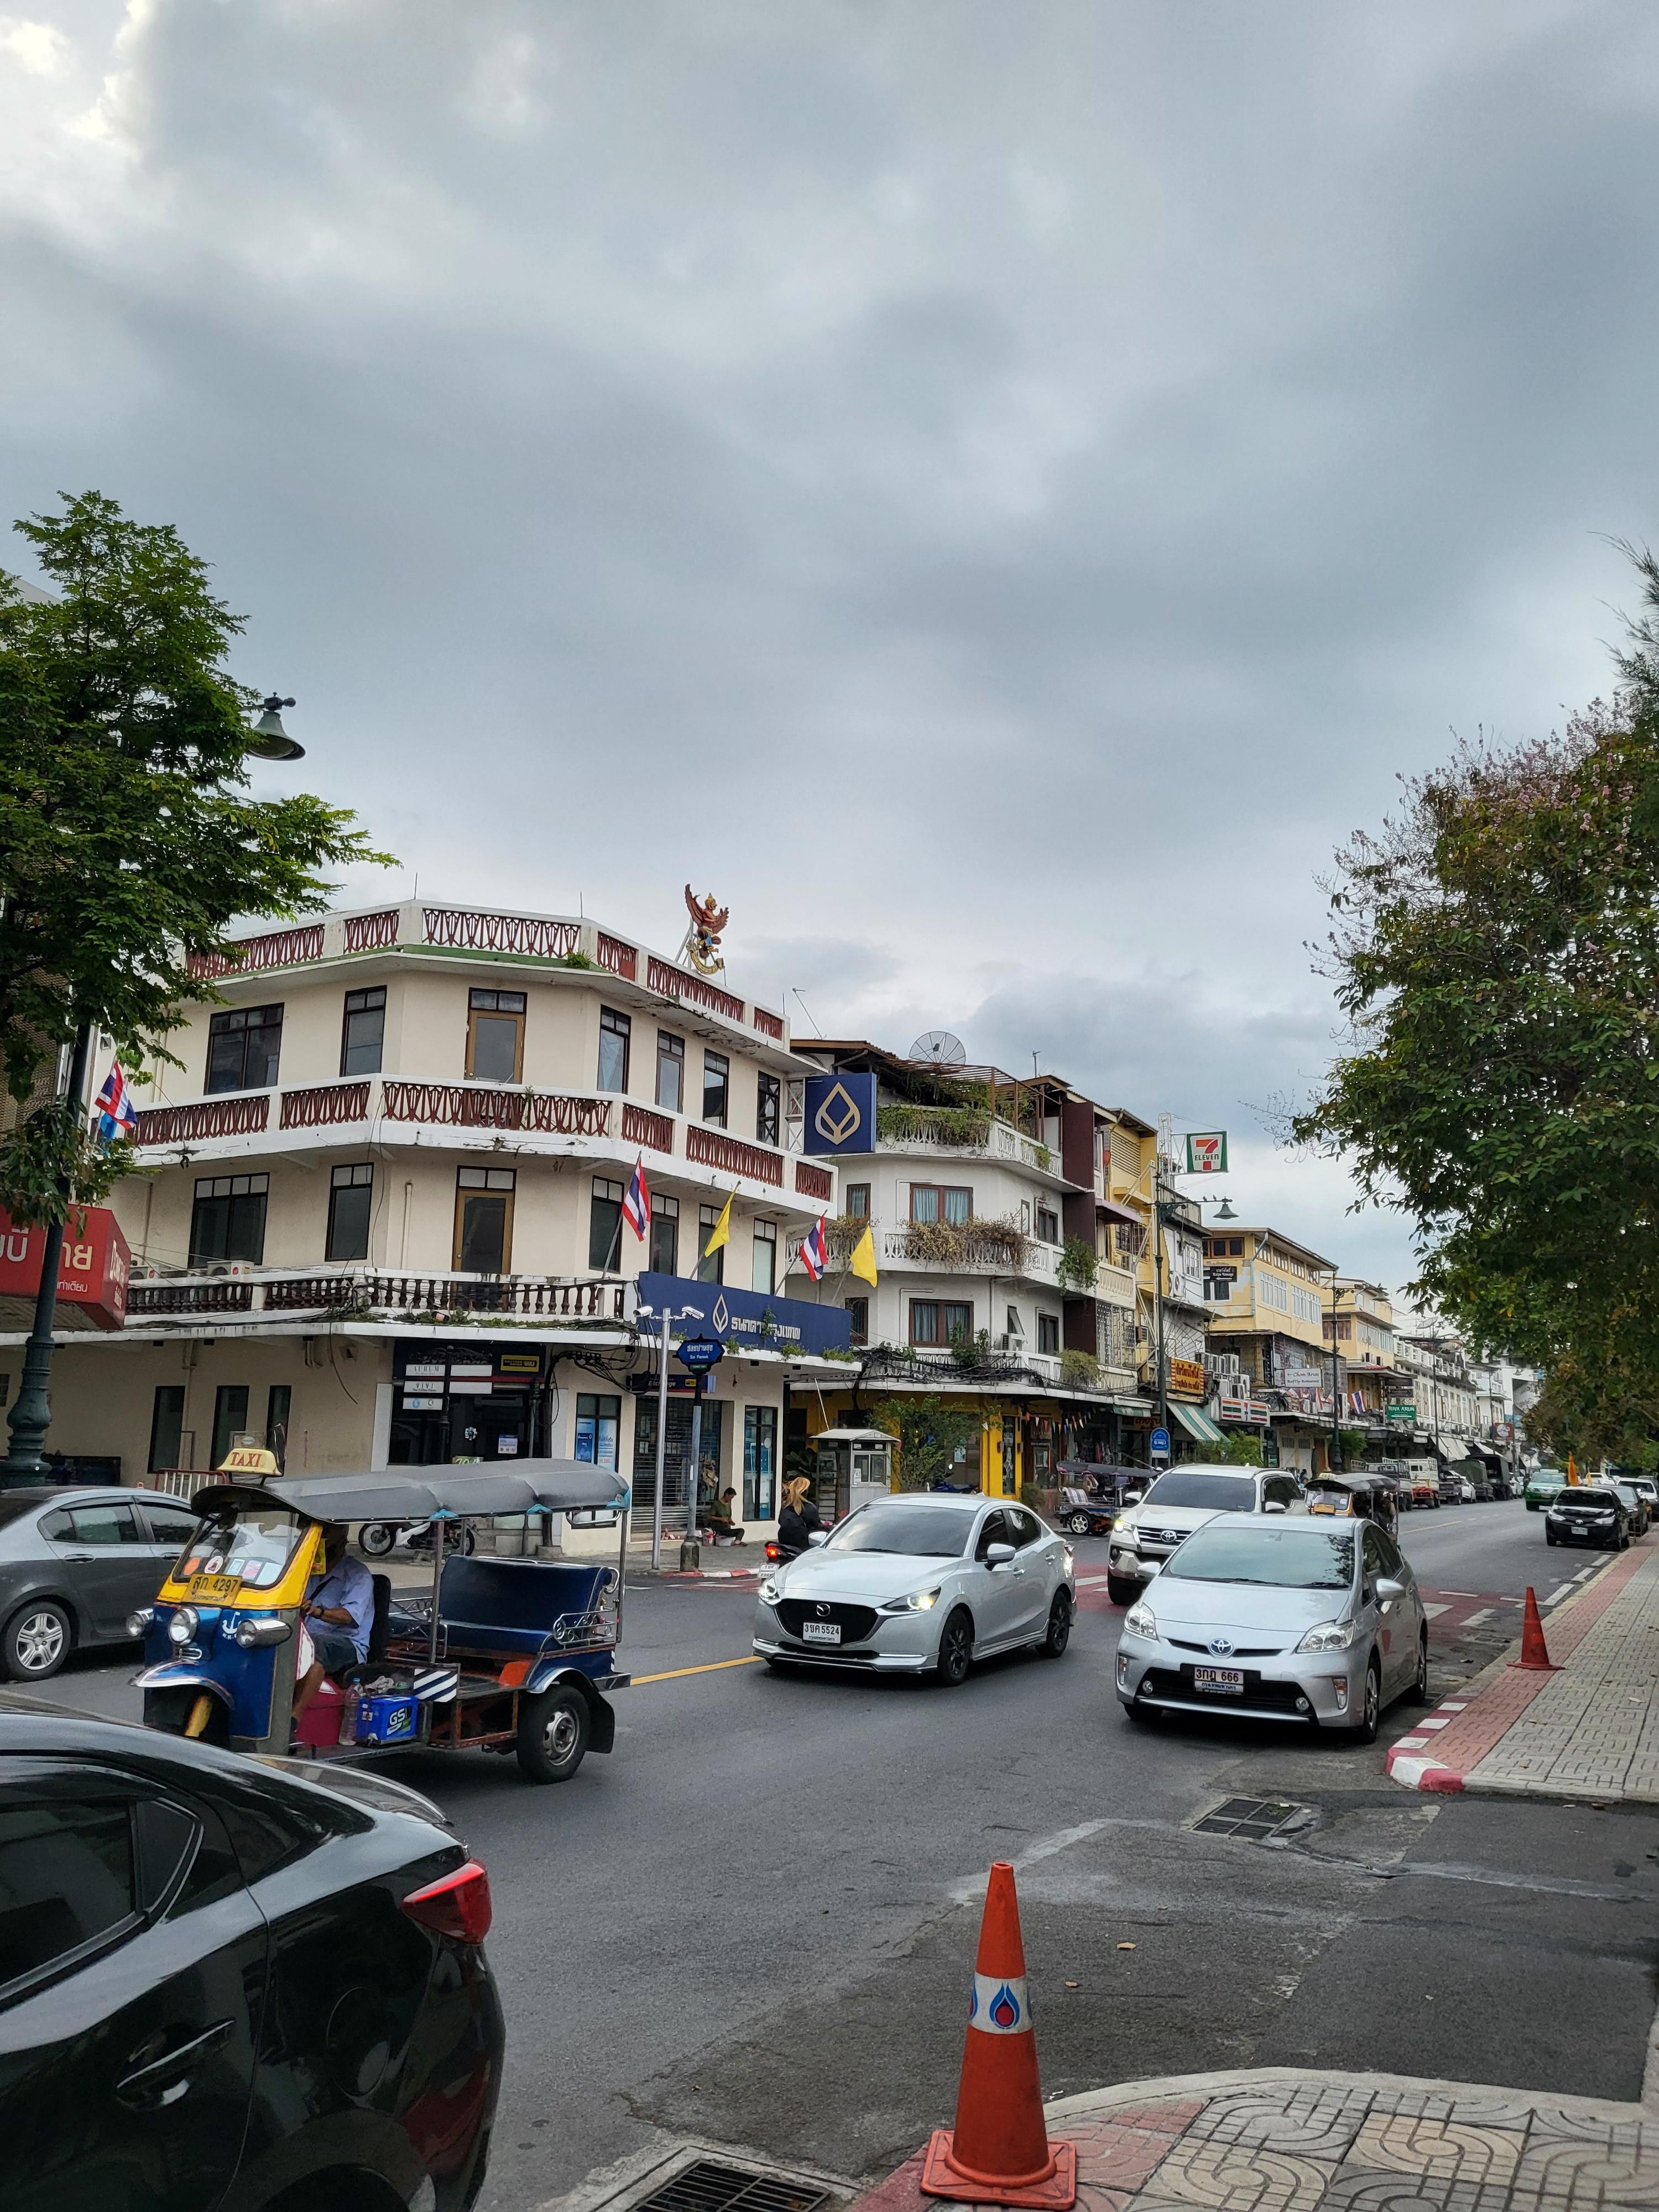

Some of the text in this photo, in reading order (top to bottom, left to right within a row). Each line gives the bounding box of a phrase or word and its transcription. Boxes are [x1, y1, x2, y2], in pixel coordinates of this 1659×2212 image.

[230, 1452, 262, 1467] TAXI
[212, 1577, 238, 1593] 4297
[821, 1625, 839, 1635] 5524
[1221, 1671, 1239, 1683] 666
[389, 1708, 405, 1725] GS
